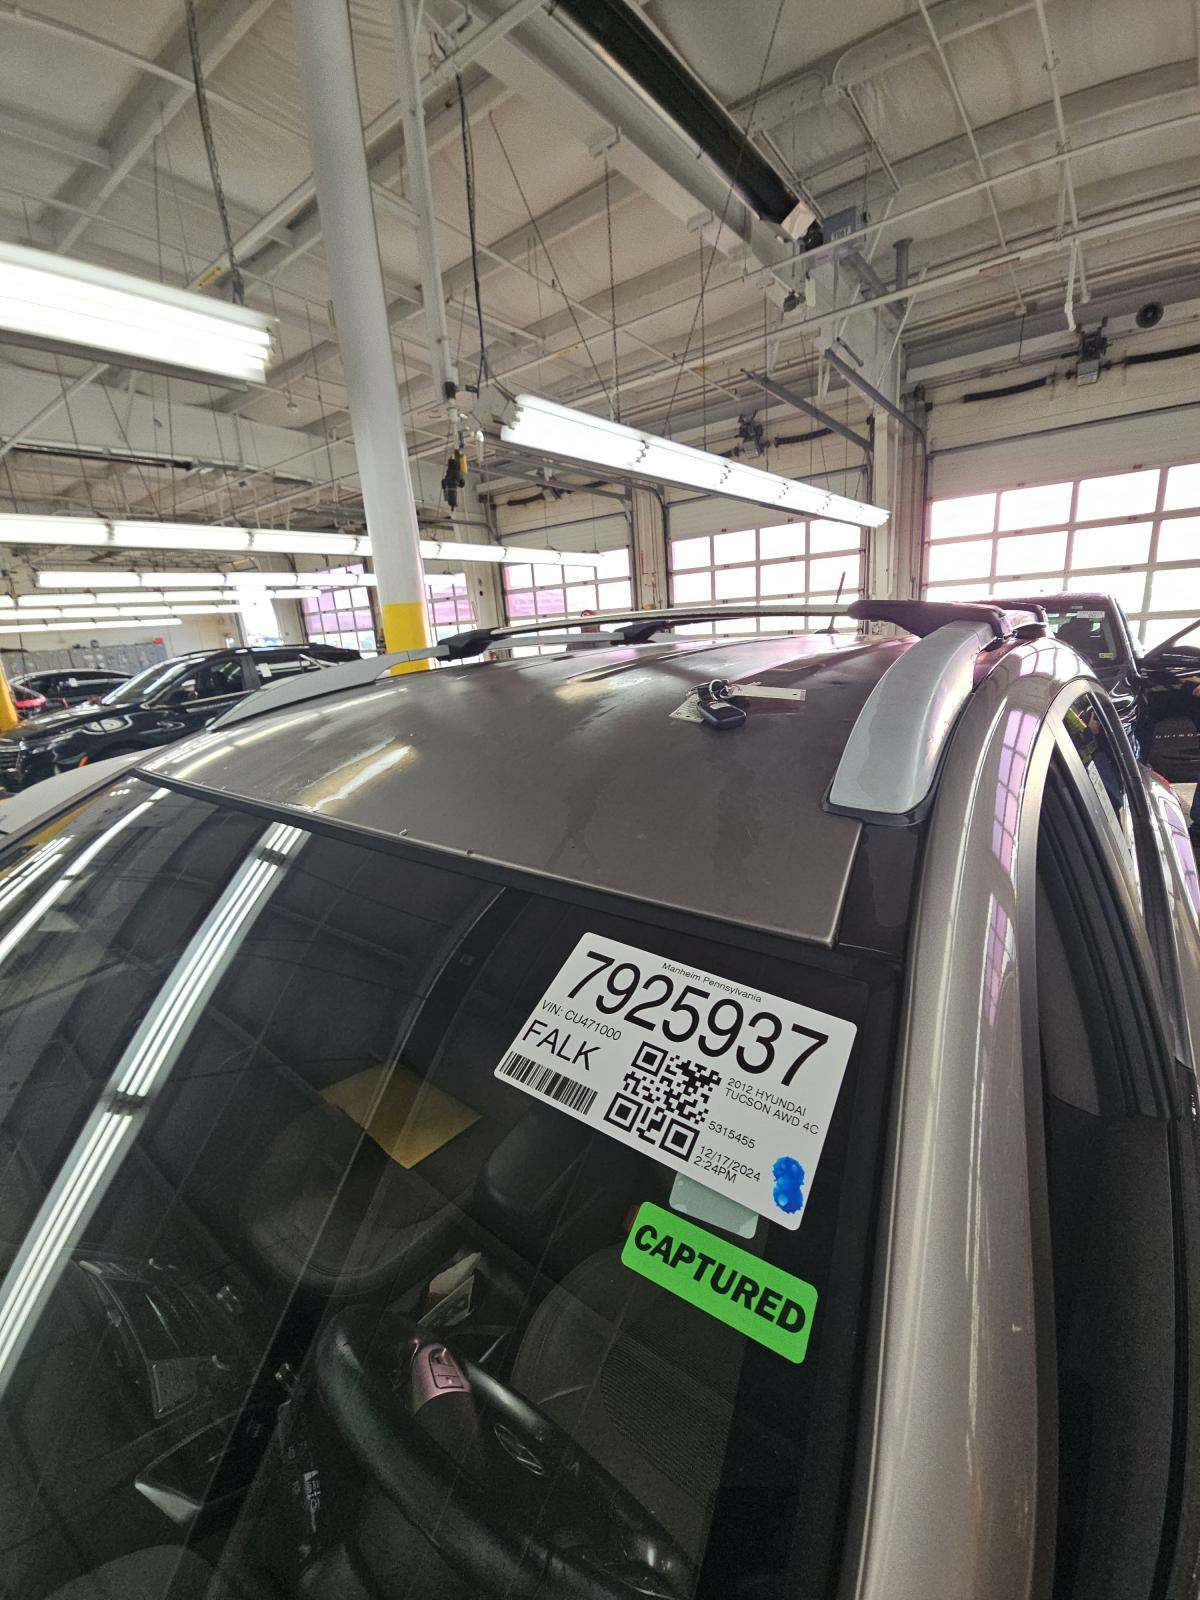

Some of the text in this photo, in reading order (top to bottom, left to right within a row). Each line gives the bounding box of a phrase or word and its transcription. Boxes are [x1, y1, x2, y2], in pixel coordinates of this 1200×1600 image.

[662, 962, 762, 1003] Manheim Pennsylvania
[541, 1000, 622, 1041] VIN: CU471000
[567, 950, 829, 1087] 7925937
[522, 1019, 601, 1071] FALK
[725, 1087, 819, 1135] TUCSON AWD 4C
[727, 1077, 806, 1117] 2012 HYUNDAI
[708, 1120, 756, 1149] 5315455
[693, 1155, 737, 1183] 2:24PM
[700, 1146, 761, 1182] 12/17/2024
[634, 1224, 806, 1334] CAPTURED
